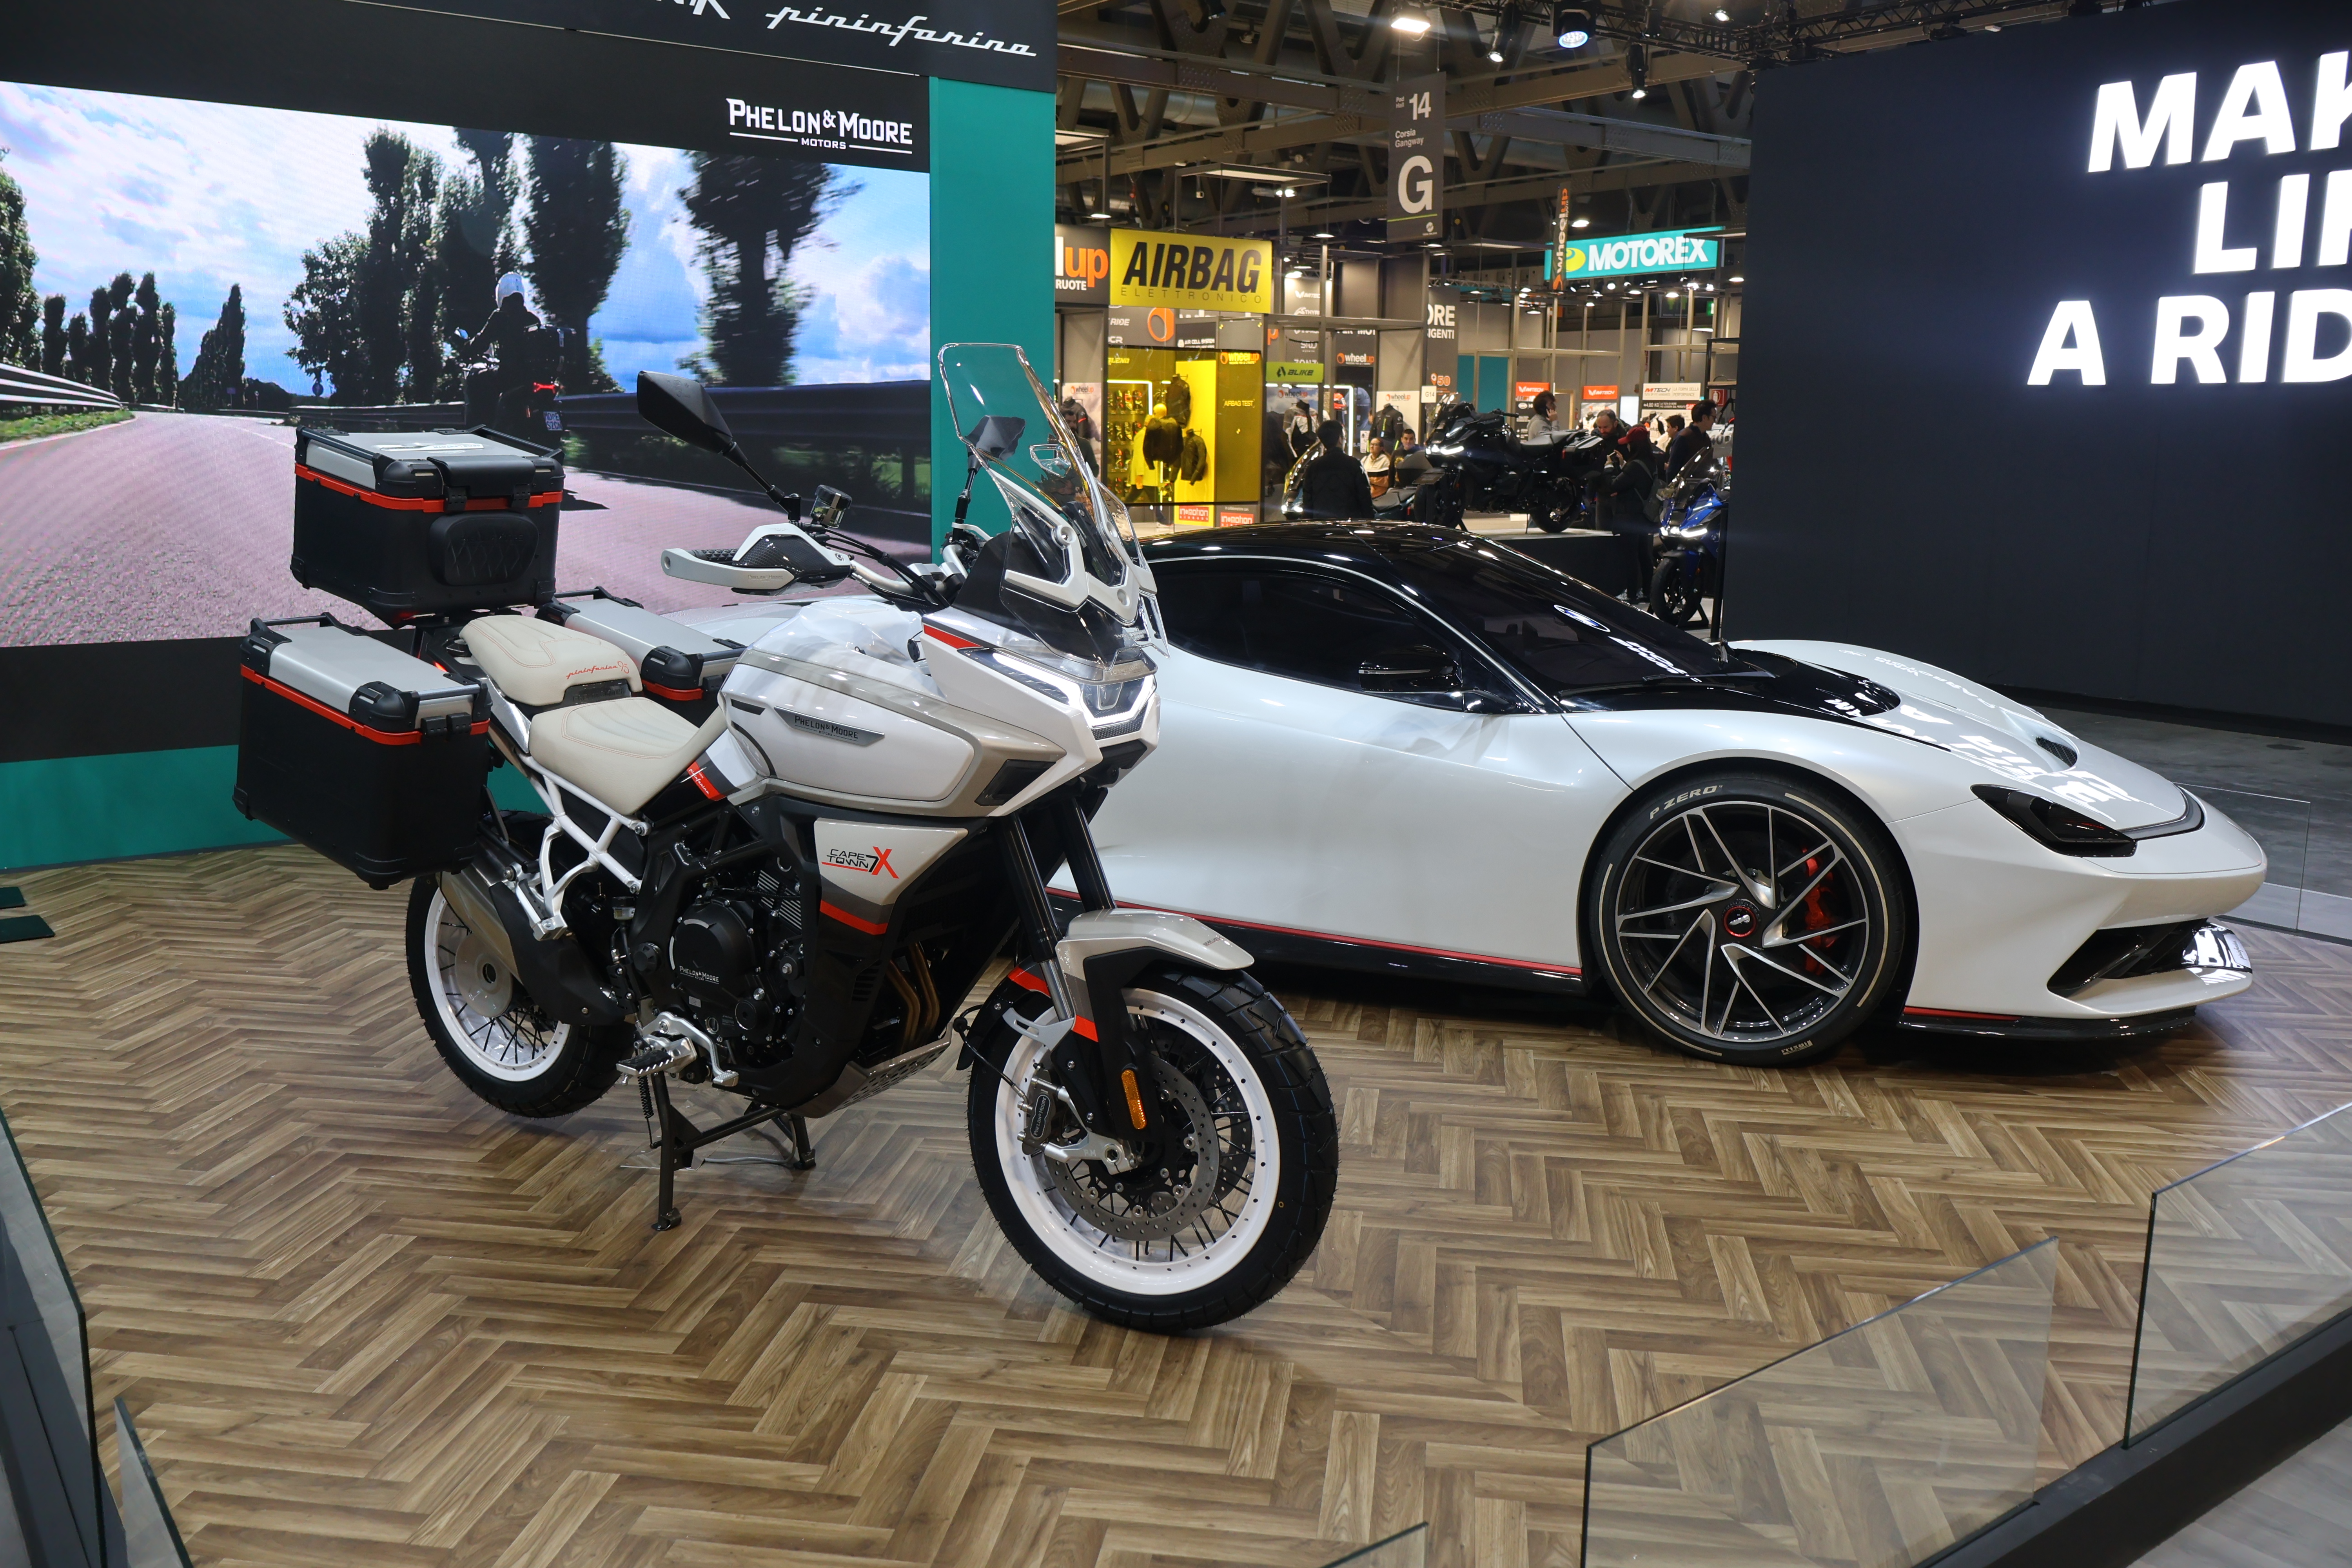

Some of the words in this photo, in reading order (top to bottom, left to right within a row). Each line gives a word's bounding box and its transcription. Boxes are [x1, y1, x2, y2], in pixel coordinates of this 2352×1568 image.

[765, 6, 1036, 57] pininfarina
[1409, 91, 1431, 121] 14
[1395, 128, 1416, 139] Corsia
[801, 137, 847, 150] MOTORS
[1395, 137, 1425, 148] Gangway
[1397, 155, 1433, 214] G
[1588, 236, 1709, 272] MOTOREX
[1123, 241, 1262, 294] AIRBAG
[1055, 279, 1087, 290] RUOTE
[1121, 287, 1262, 304] ELETTRONICO
[1110, 318, 1131, 326] RIDE
[1427, 328, 1455, 339] IGENTI
[2027, 300, 2107, 386] A
[1345, 353, 1375, 364] wheelup
[1437, 375, 1451, 387] 50
[1075, 385, 1094, 394] wheelup
[1285, 389, 1308, 399] wheelup
[565, 665, 619, 680] pininfarina
[1650, 806, 1660, 820] P
[1664, 785, 1718, 810] ZERO
[827, 855, 869, 868] TOWN
[830, 849, 867, 861] CAPE
